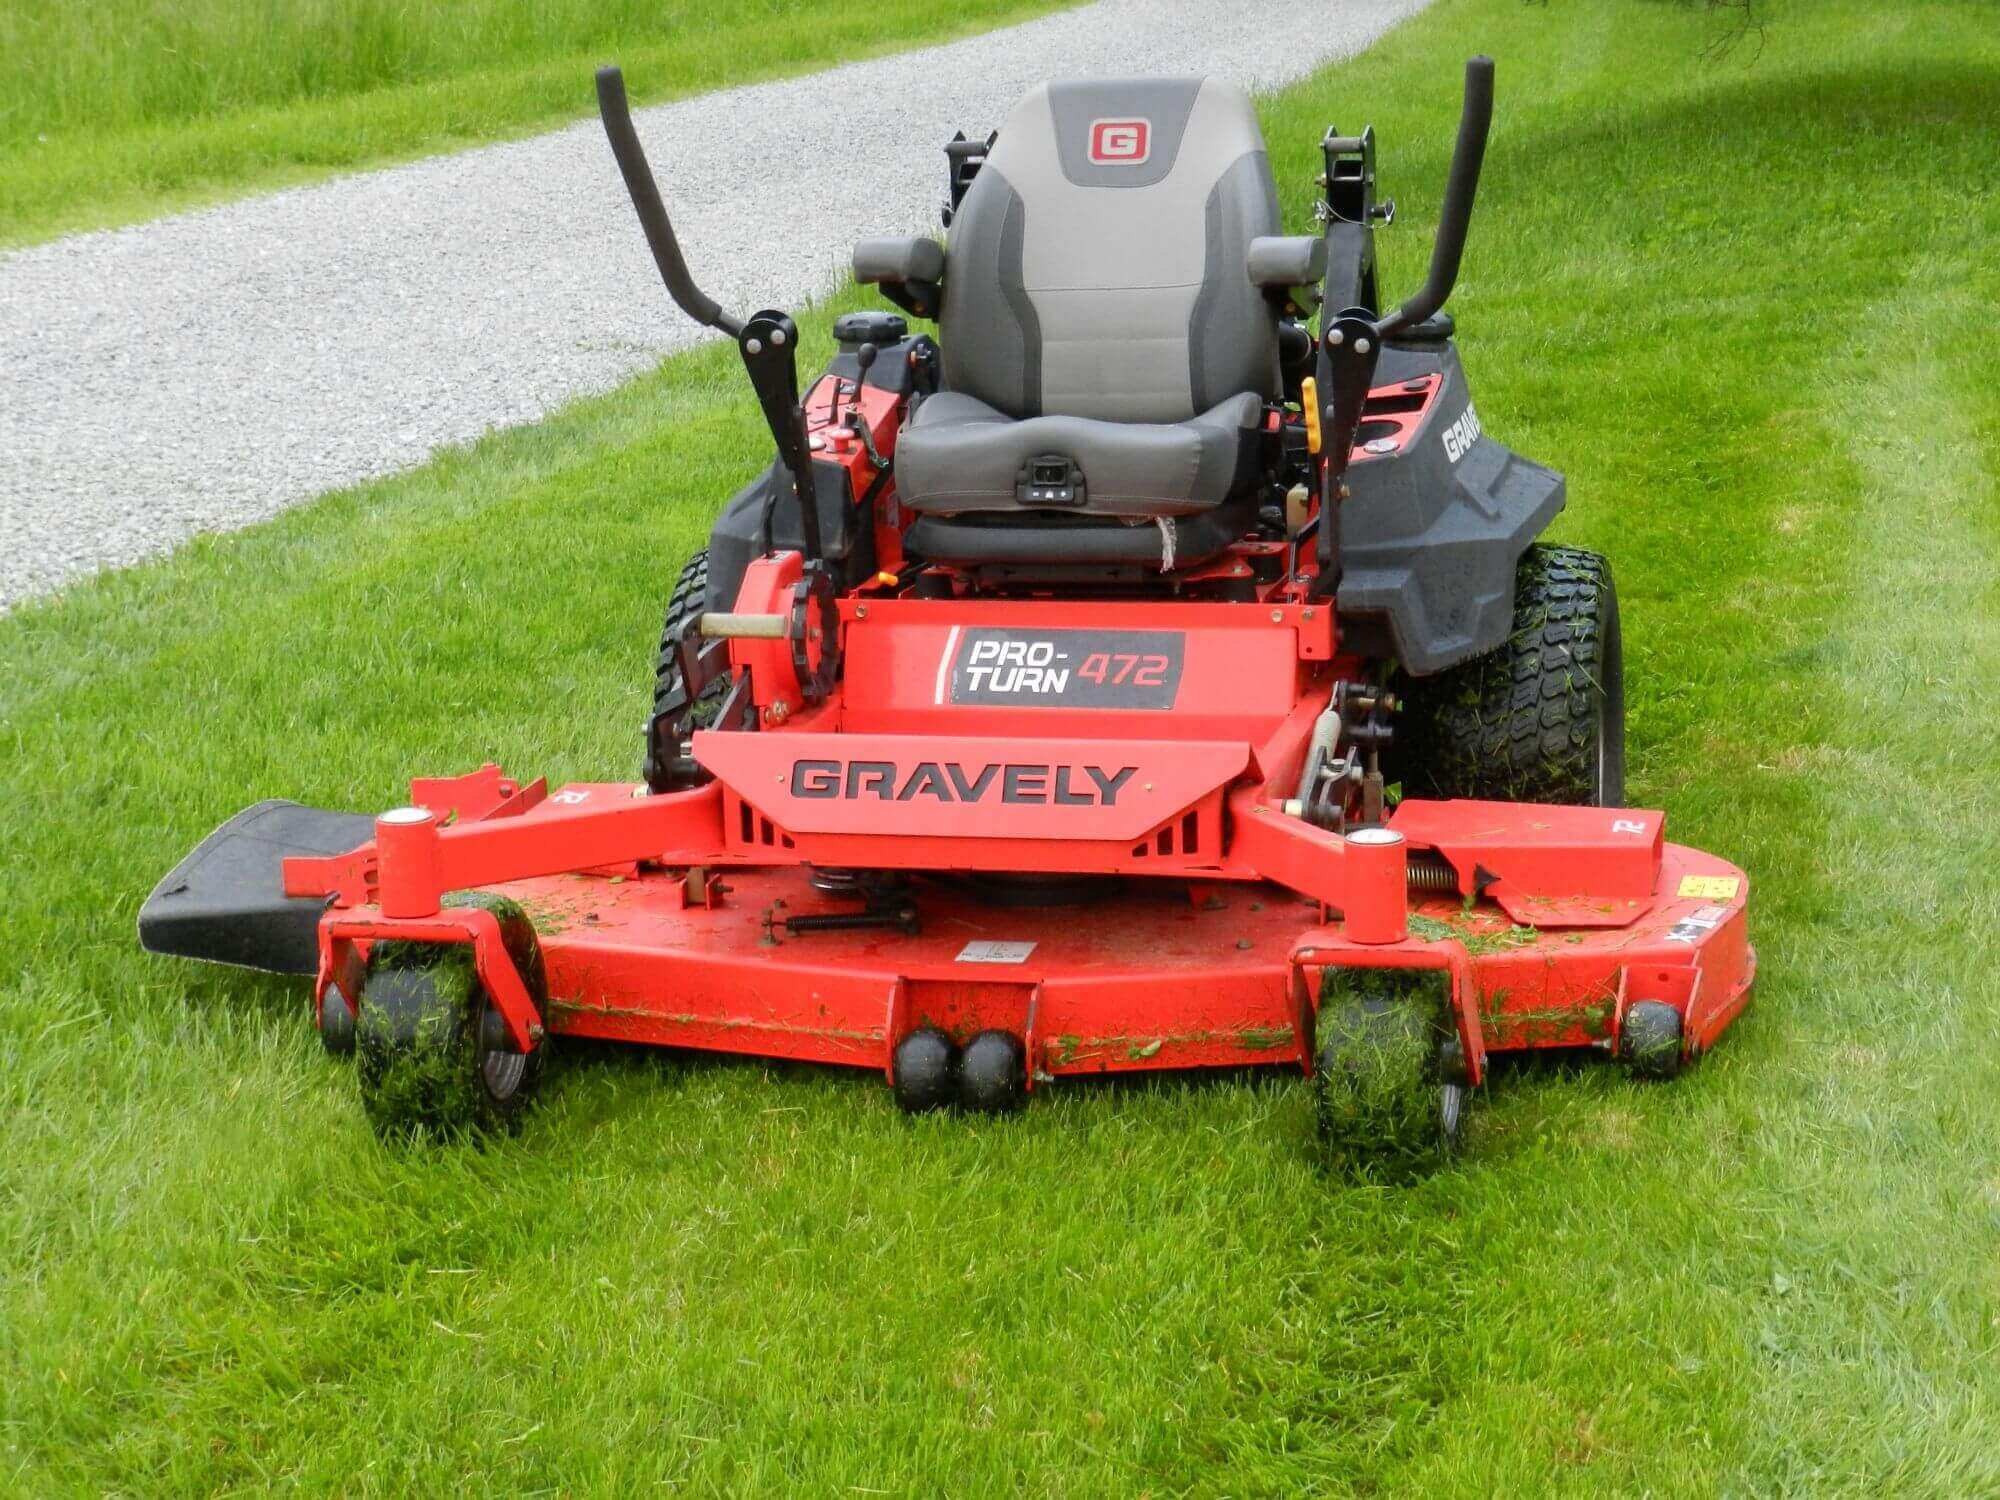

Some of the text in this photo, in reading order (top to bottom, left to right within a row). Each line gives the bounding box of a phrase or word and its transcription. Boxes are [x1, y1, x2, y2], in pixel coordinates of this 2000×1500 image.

[969, 640, 1068, 667] PRO-
[966, 666, 1070, 694] TURN
[1077, 653, 1169, 686] 472
[790, 759, 1140, 806] GRAVELY
